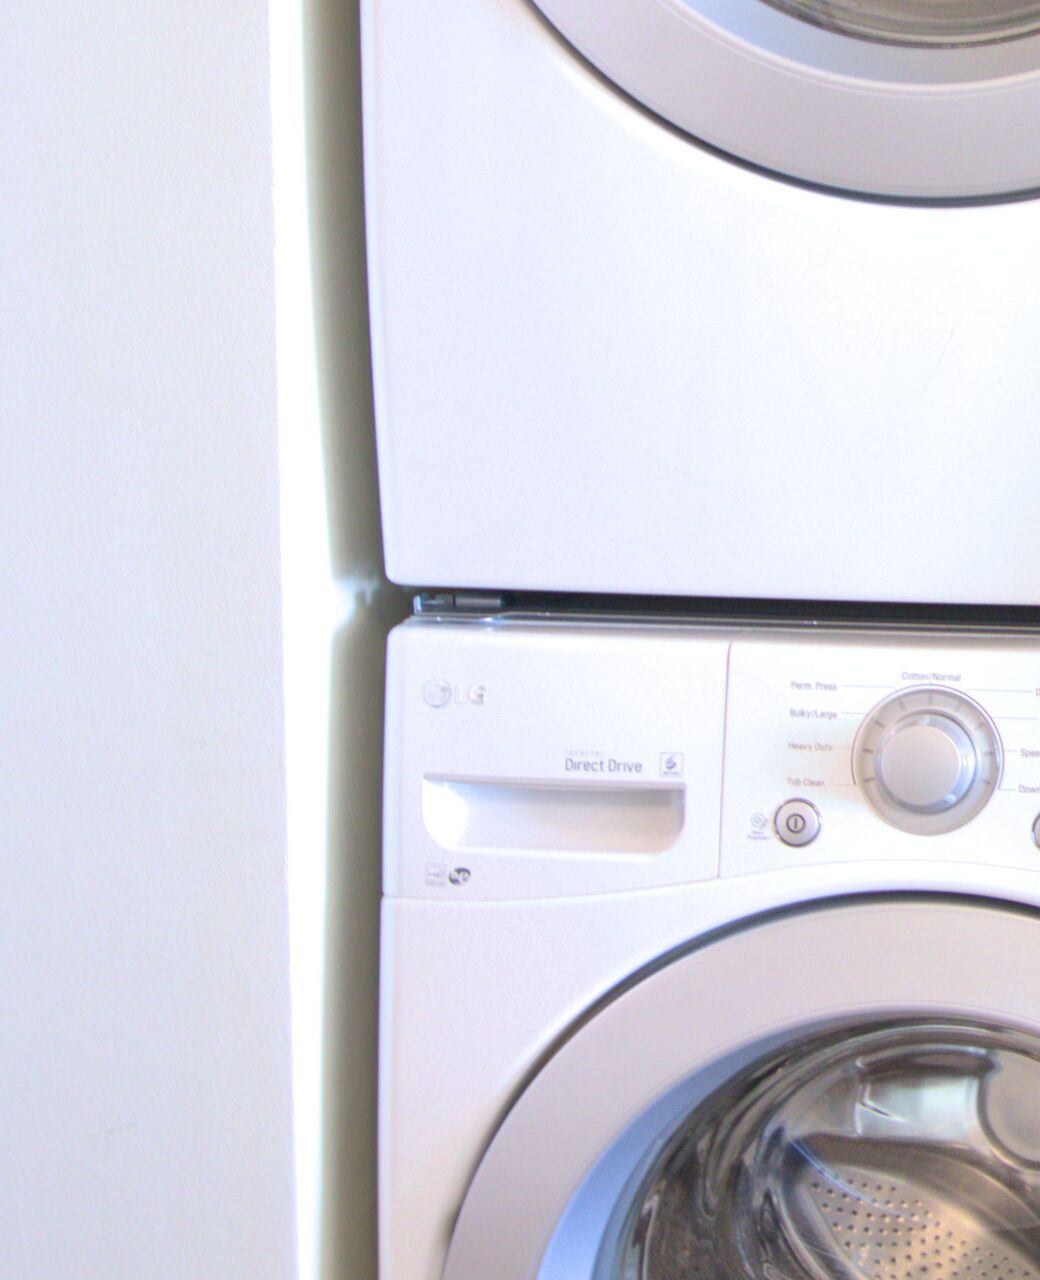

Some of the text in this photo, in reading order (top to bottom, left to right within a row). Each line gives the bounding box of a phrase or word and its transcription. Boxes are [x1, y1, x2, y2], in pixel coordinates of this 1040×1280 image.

[901, 672, 962, 682] Cotton/Normal
[815, 681, 838, 692] Press
[788, 708, 838, 721] Bulky/Large
[787, 741, 833, 753] Heavy Duty
[564, 757, 643, 774] Direct Drive
[803, 778, 825, 787] Clean
